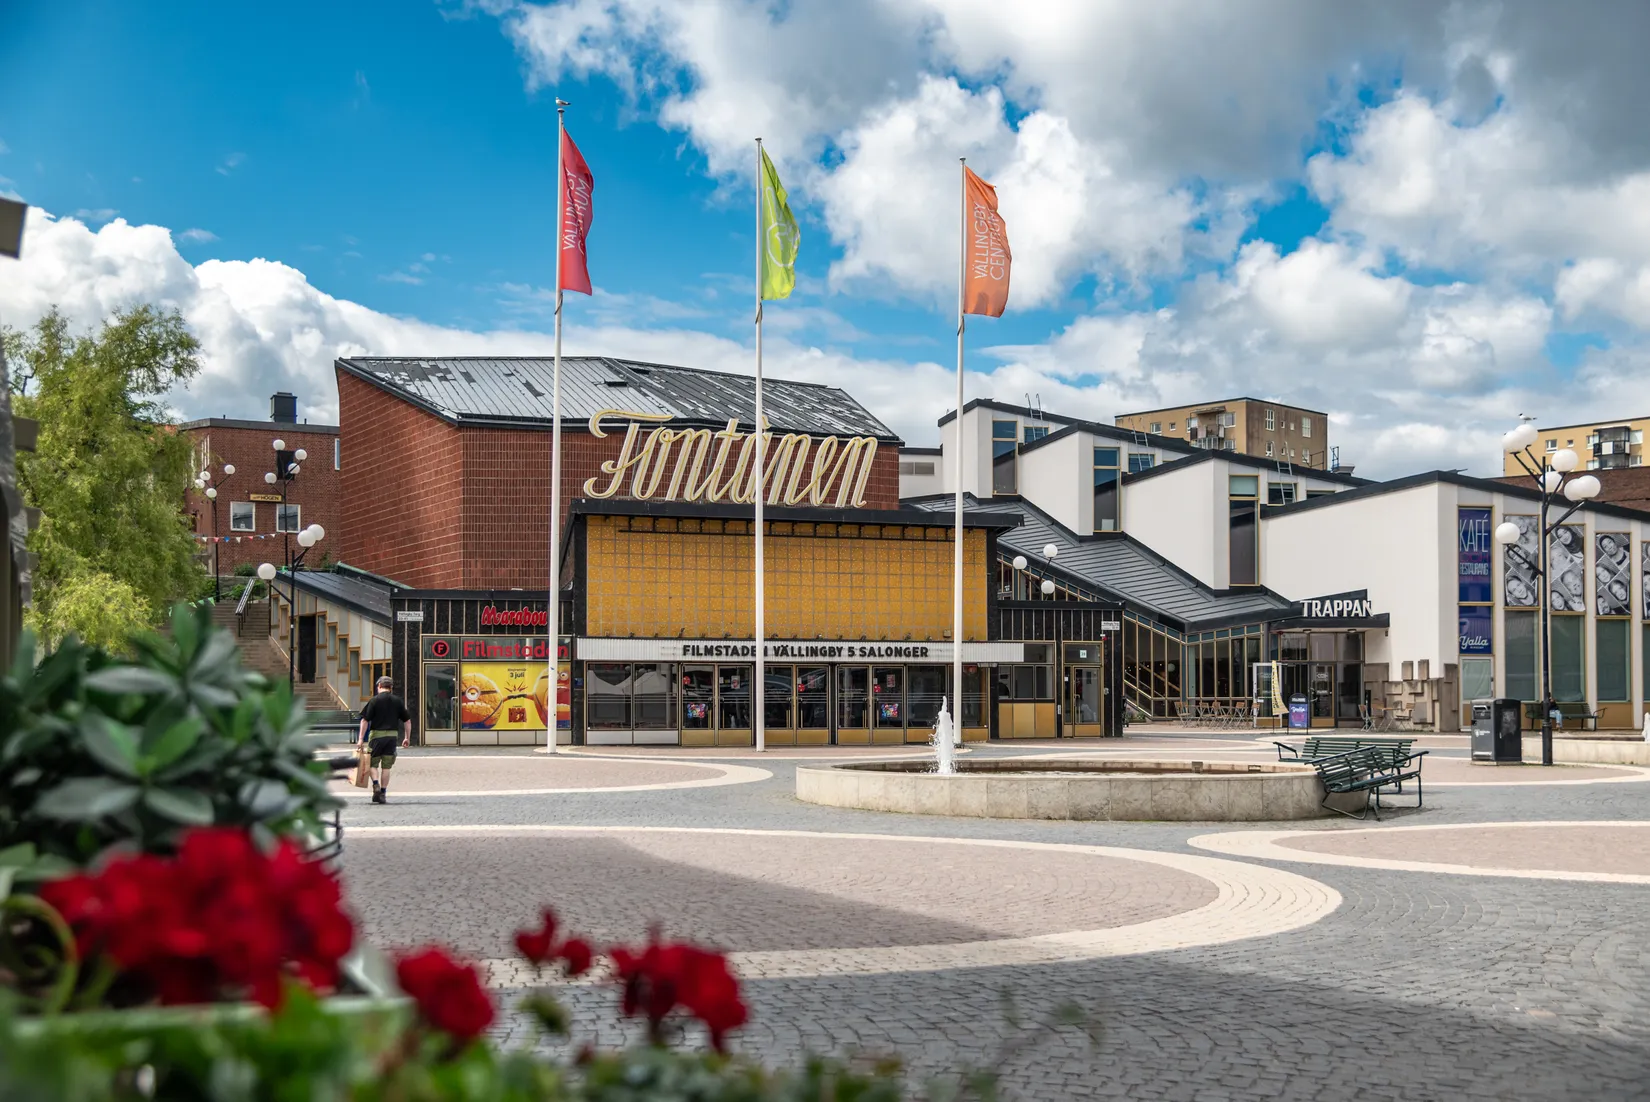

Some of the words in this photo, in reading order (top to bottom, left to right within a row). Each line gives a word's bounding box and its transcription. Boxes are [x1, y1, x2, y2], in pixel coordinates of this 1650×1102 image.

[574, 178, 591, 255] CRUM
[972, 203, 988, 279] VÄLLINGBY
[1459, 513, 1488, 552] KAFÉ
[1459, 562, 1488, 575] RESTAURANG
[481, 605, 548, 626] Marabou
[1300, 599, 1374, 617] TRAPPAN
[463, 640, 568, 657] Filmstadn
[773, 645, 843, 657] VÄLLINGBY
[848, 646, 855, 657] 5
[859, 646, 928, 657] SALONGER
[1459, 636, 1488, 649] Yalla
